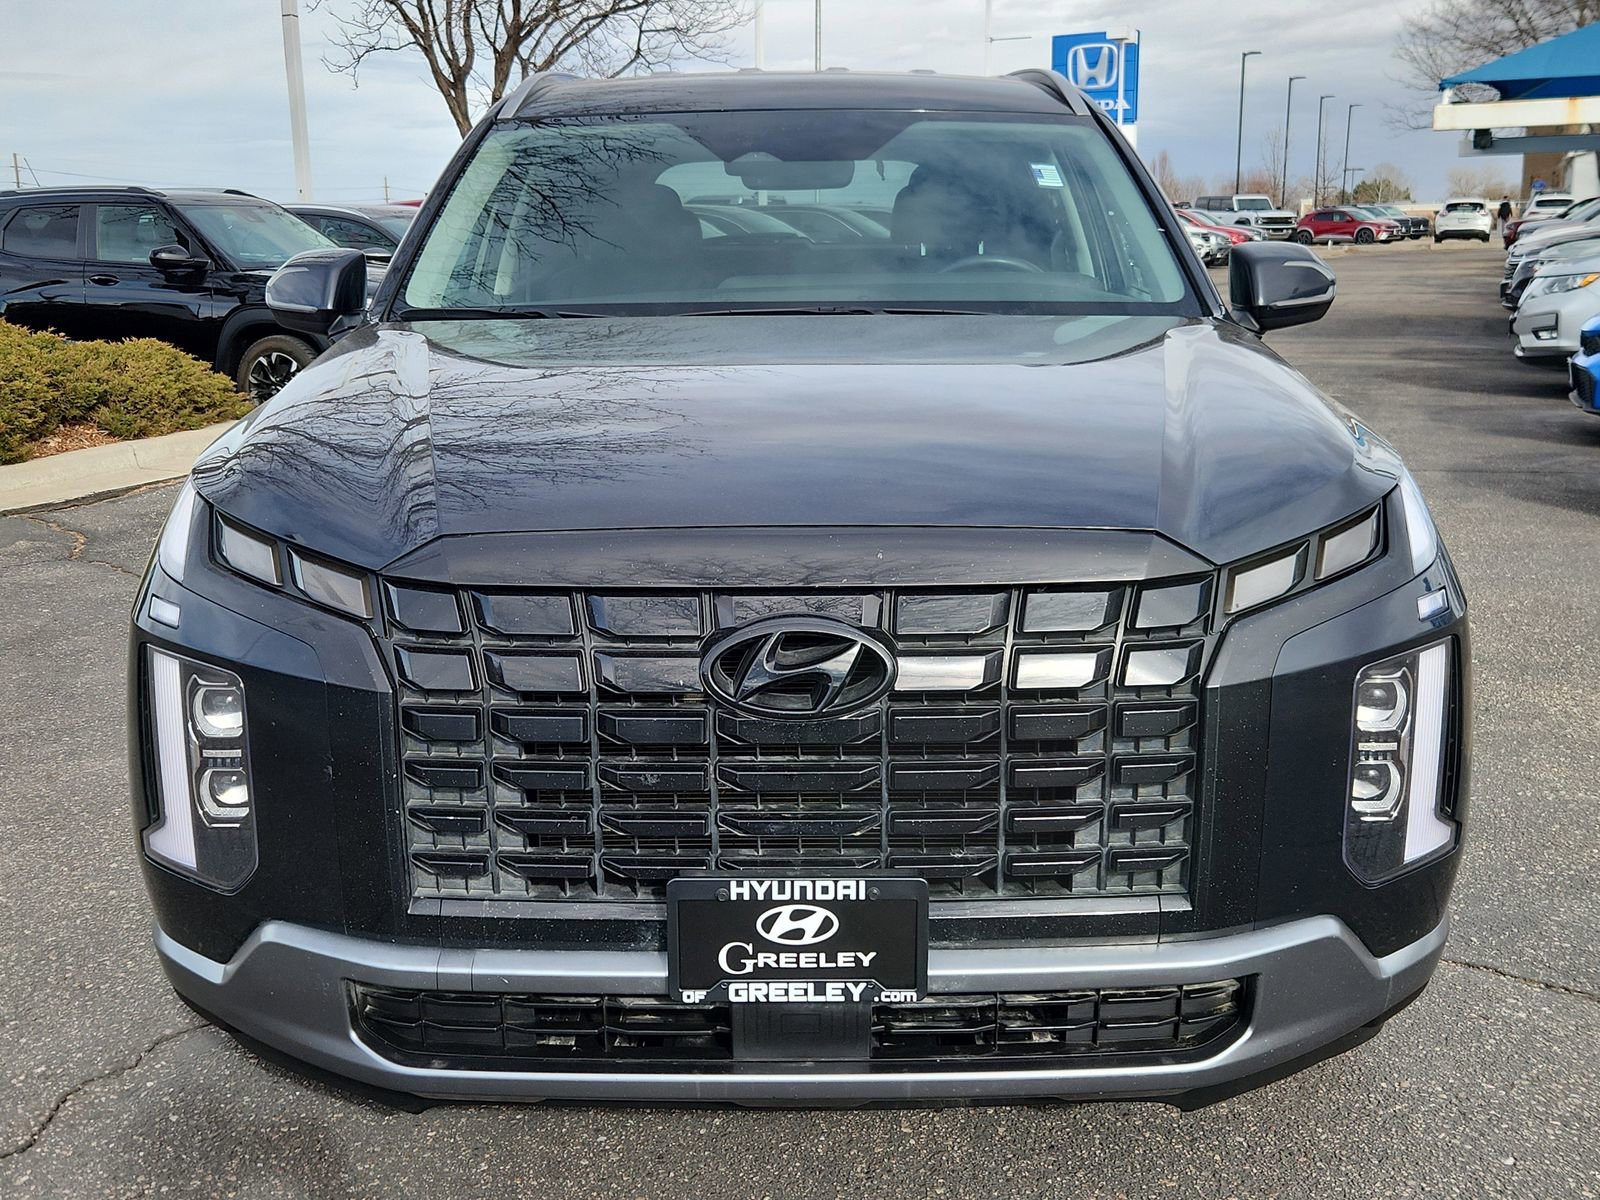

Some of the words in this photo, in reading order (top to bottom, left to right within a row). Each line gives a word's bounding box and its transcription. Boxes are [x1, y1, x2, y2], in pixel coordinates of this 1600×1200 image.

[730, 880, 866, 901] HYUNDAI
[718, 941, 877, 974] GREELEY
[682, 990, 707, 1004] OF
[728, 982, 867, 1003] GREELEY
[873, 990, 918, 1003] .com
